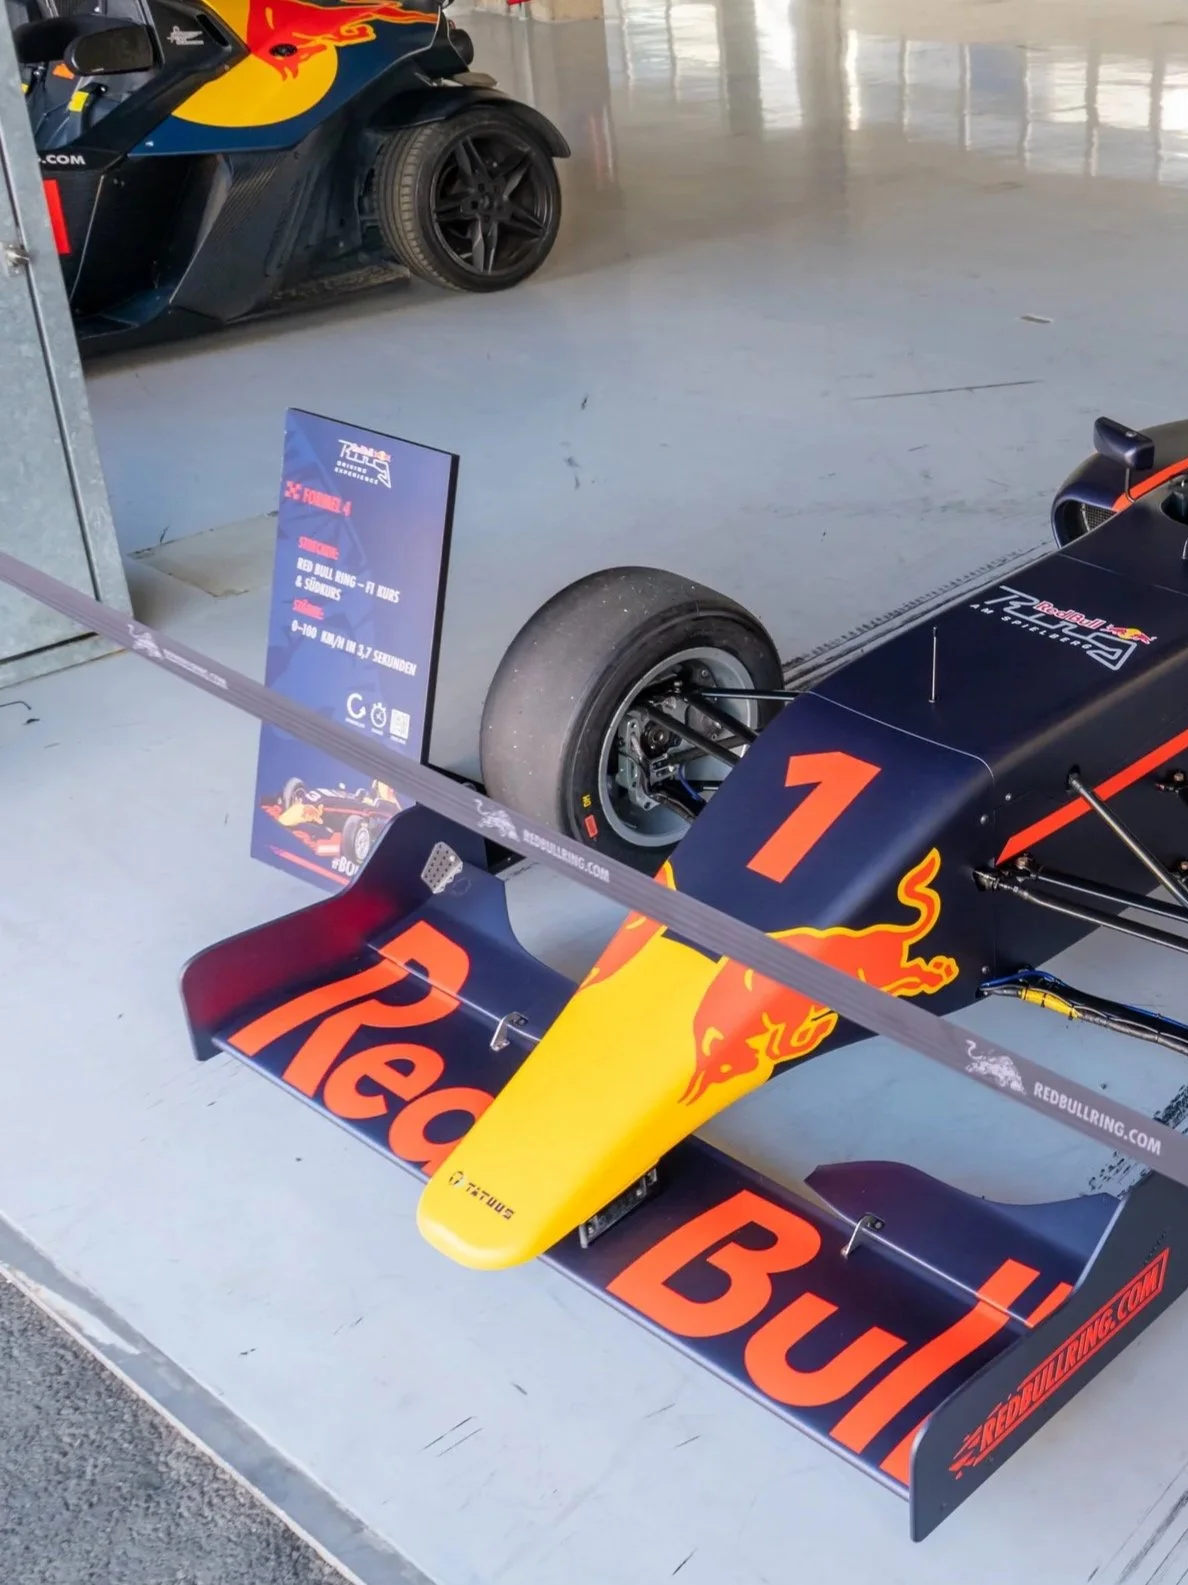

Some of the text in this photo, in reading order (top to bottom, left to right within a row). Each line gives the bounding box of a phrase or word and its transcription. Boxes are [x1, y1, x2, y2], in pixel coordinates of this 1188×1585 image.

[38, 154, 86, 165] .COM
[297, 557, 314, 573] RED
[314, 563, 334, 580] BULL
[334, 570, 357, 588] RING
[376, 585, 400, 604] KURS
[970, 603, 1092, 650] AM SPIELBERG
[372, 650, 417, 676] SEKUNDEN
[746, 751, 881, 884] 1
[1034, 1081, 1162, 1156] REDBULLRING.COM
[466, 1182, 515, 1220] TATUUS
